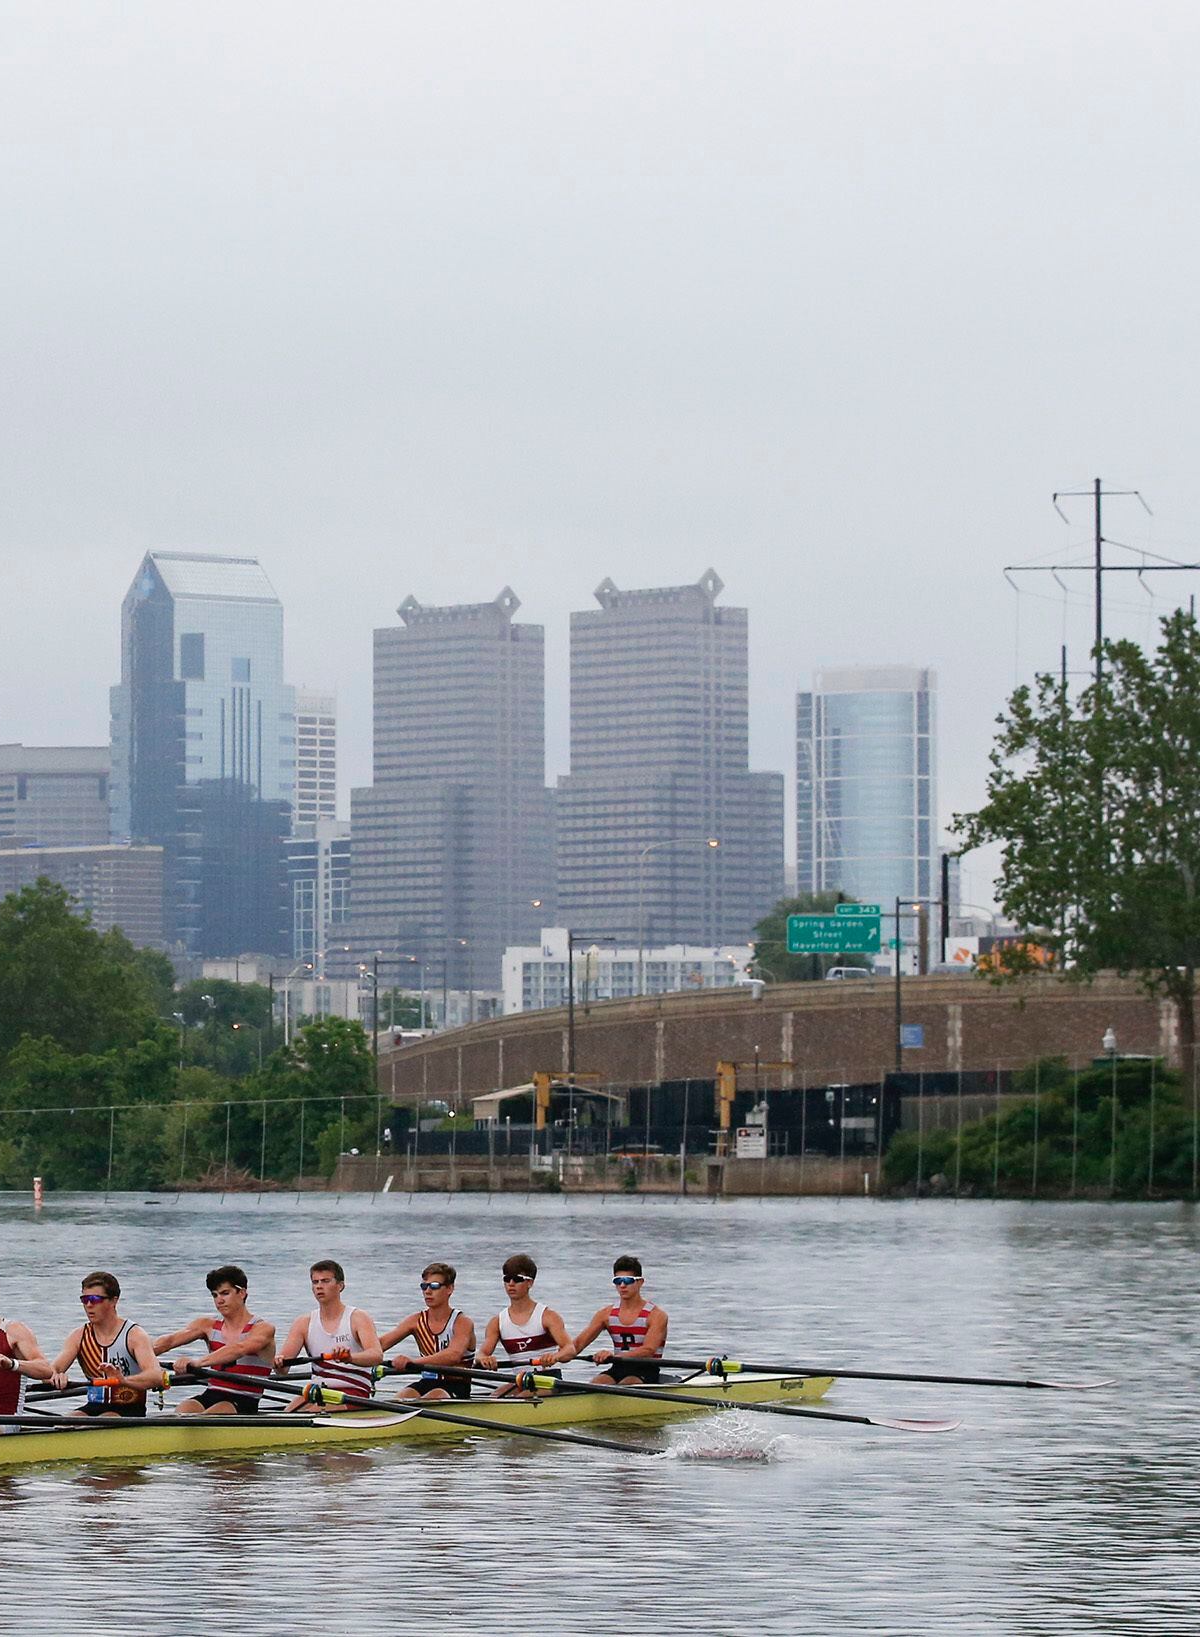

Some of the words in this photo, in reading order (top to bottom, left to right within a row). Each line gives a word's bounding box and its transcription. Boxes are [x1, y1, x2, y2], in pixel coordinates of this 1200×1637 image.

[858, 906, 876, 914] 343
[792, 919, 825, 929] Spring
[829, 919, 864, 928] Garden
[792, 941, 840, 949] Haverford
